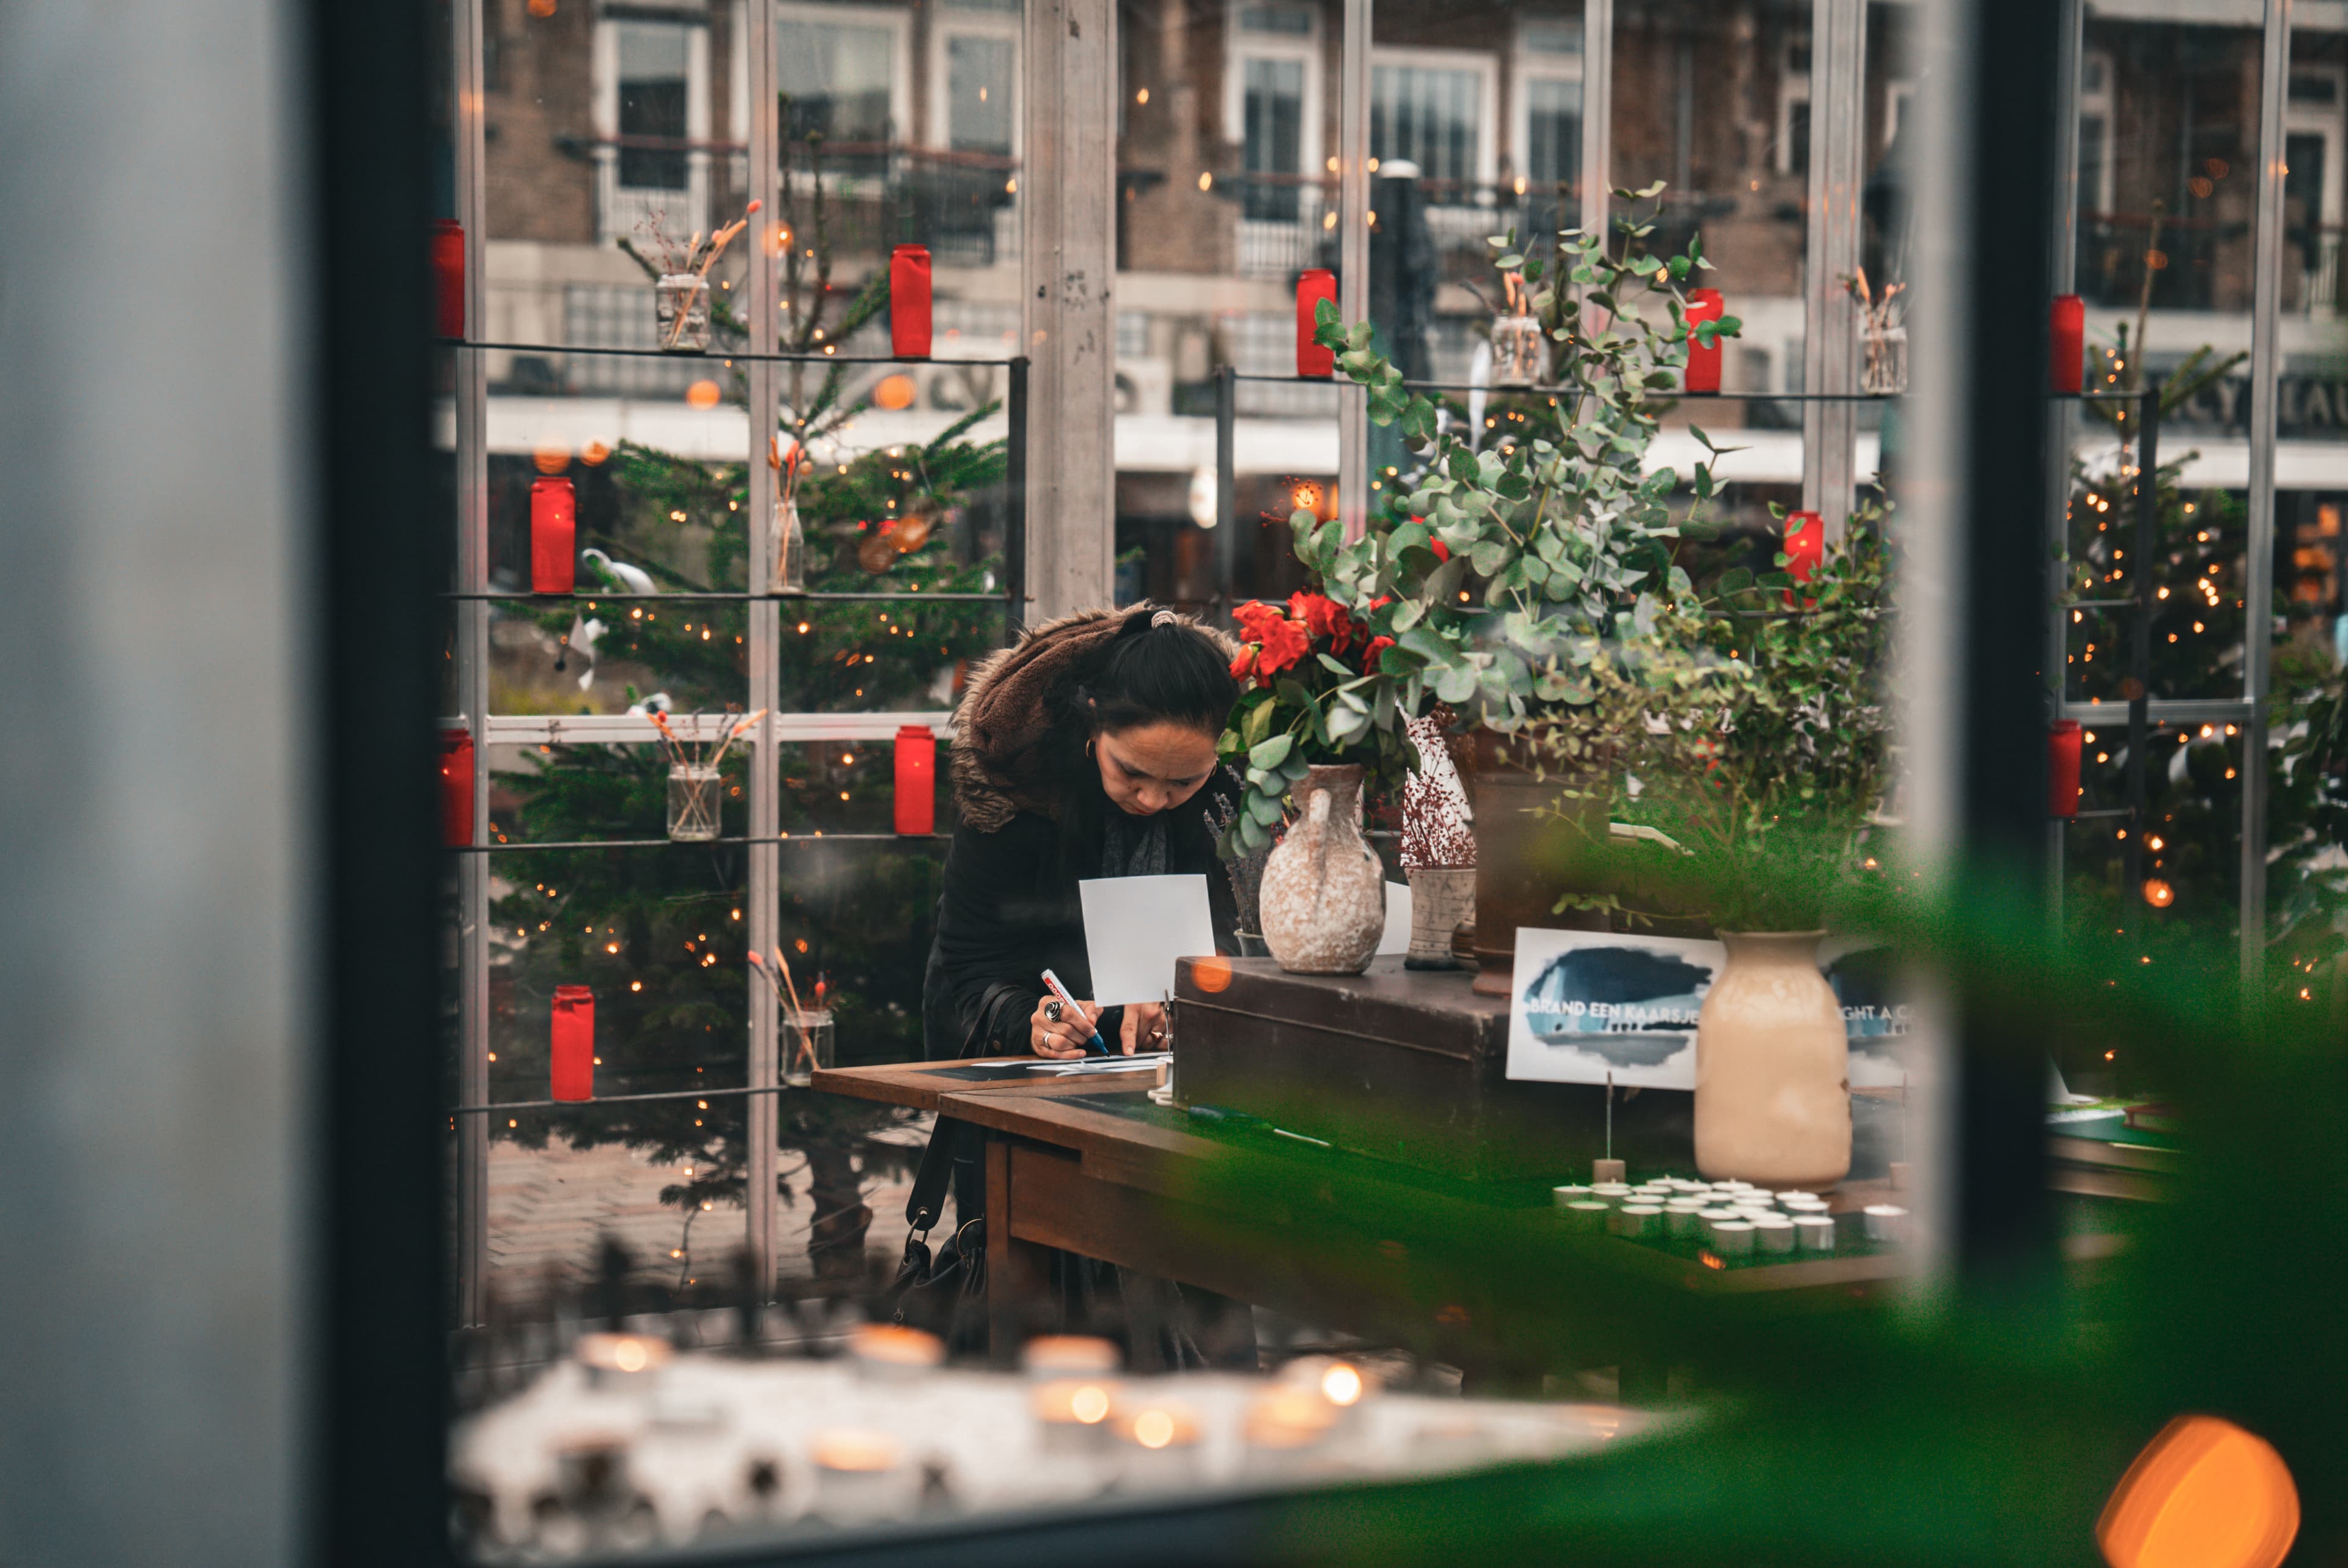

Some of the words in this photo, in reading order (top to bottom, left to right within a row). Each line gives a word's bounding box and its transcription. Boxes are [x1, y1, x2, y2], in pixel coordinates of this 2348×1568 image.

[1530, 998, 1586, 1017] BRAND
[1590, 1001, 1620, 1018] EEN
[1623, 1004, 1700, 1024] KAARSJE
[1880, 1004, 1893, 1020] A
